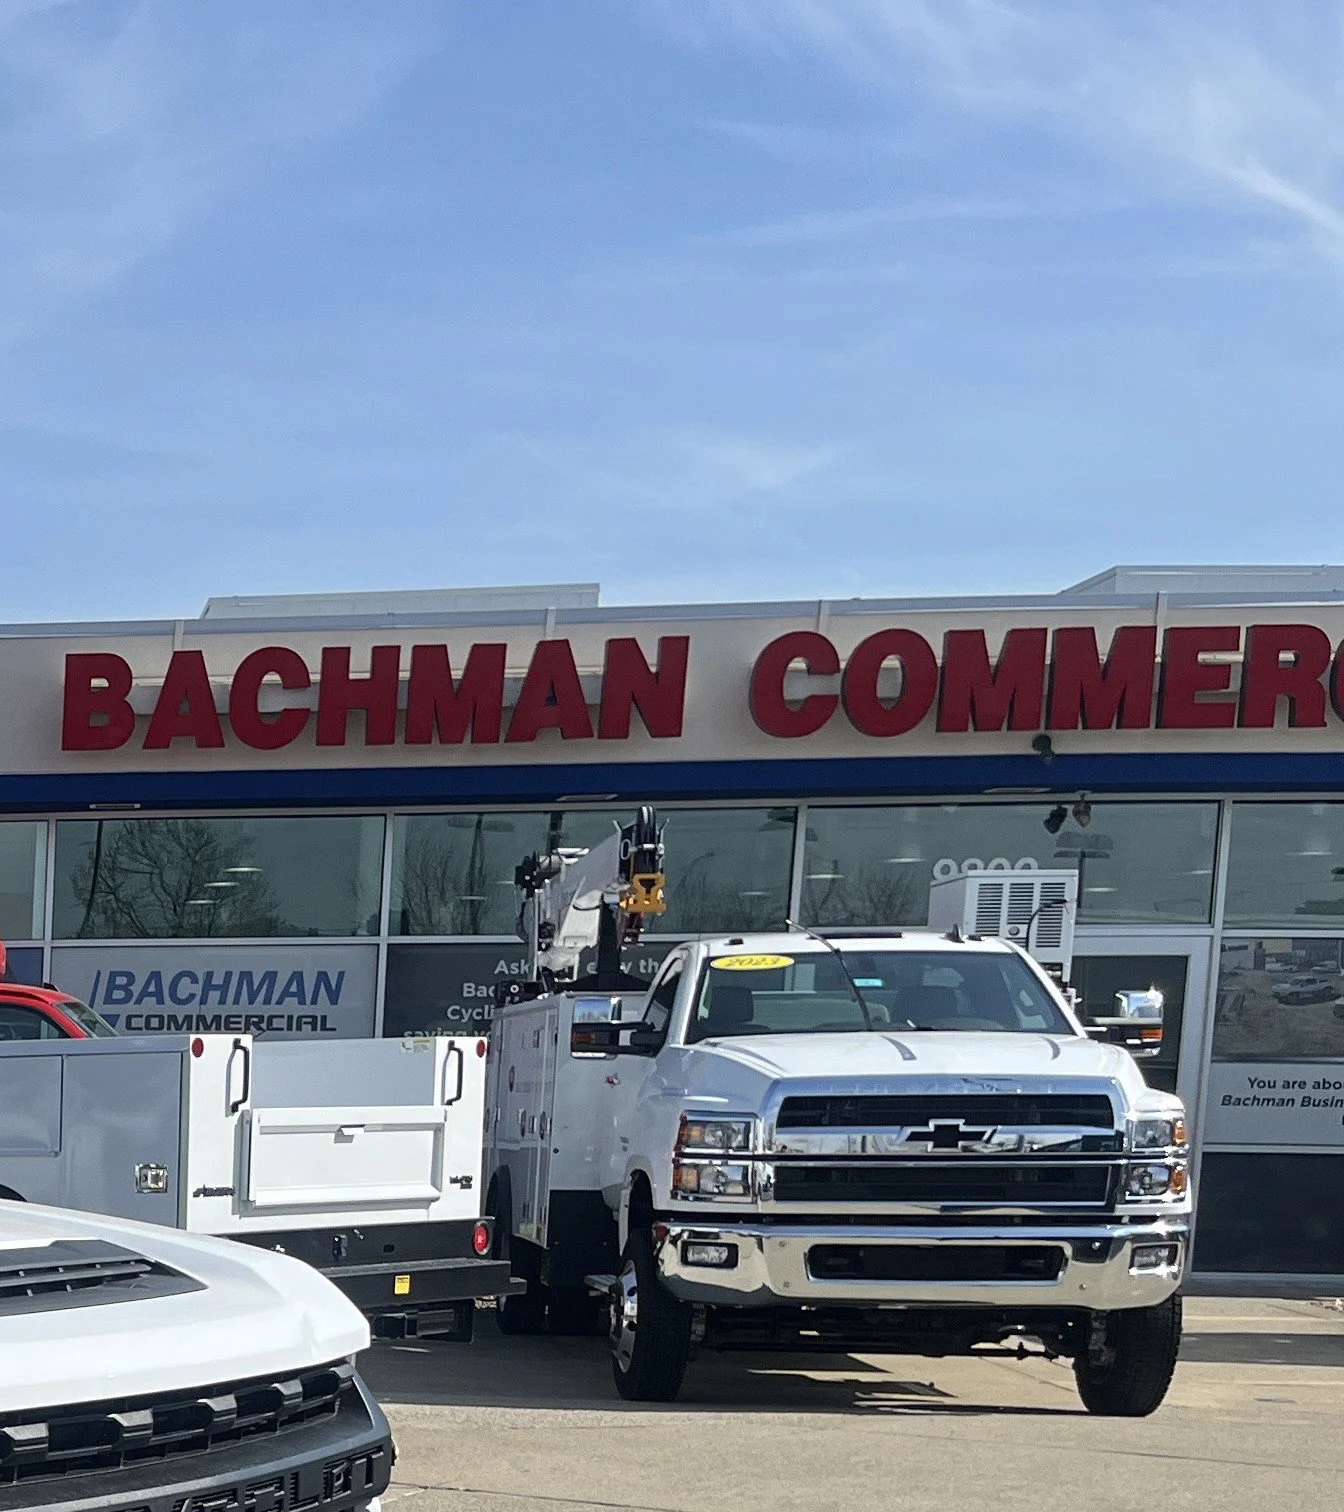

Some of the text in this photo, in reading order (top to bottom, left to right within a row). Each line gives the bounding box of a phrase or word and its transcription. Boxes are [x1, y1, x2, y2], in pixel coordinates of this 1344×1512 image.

[61, 623, 1344, 750] BACHMAN COMMER
[494, 960, 530, 975] Ask
[102, 970, 346, 1006] BACHMAN
[124, 1013, 337, 1032] COMMERCIAL
[1247, 1077, 1277, 1089] You
[1282, 1080, 1307, 1090] are
[1221, 1095, 1295, 1107] Bachman
